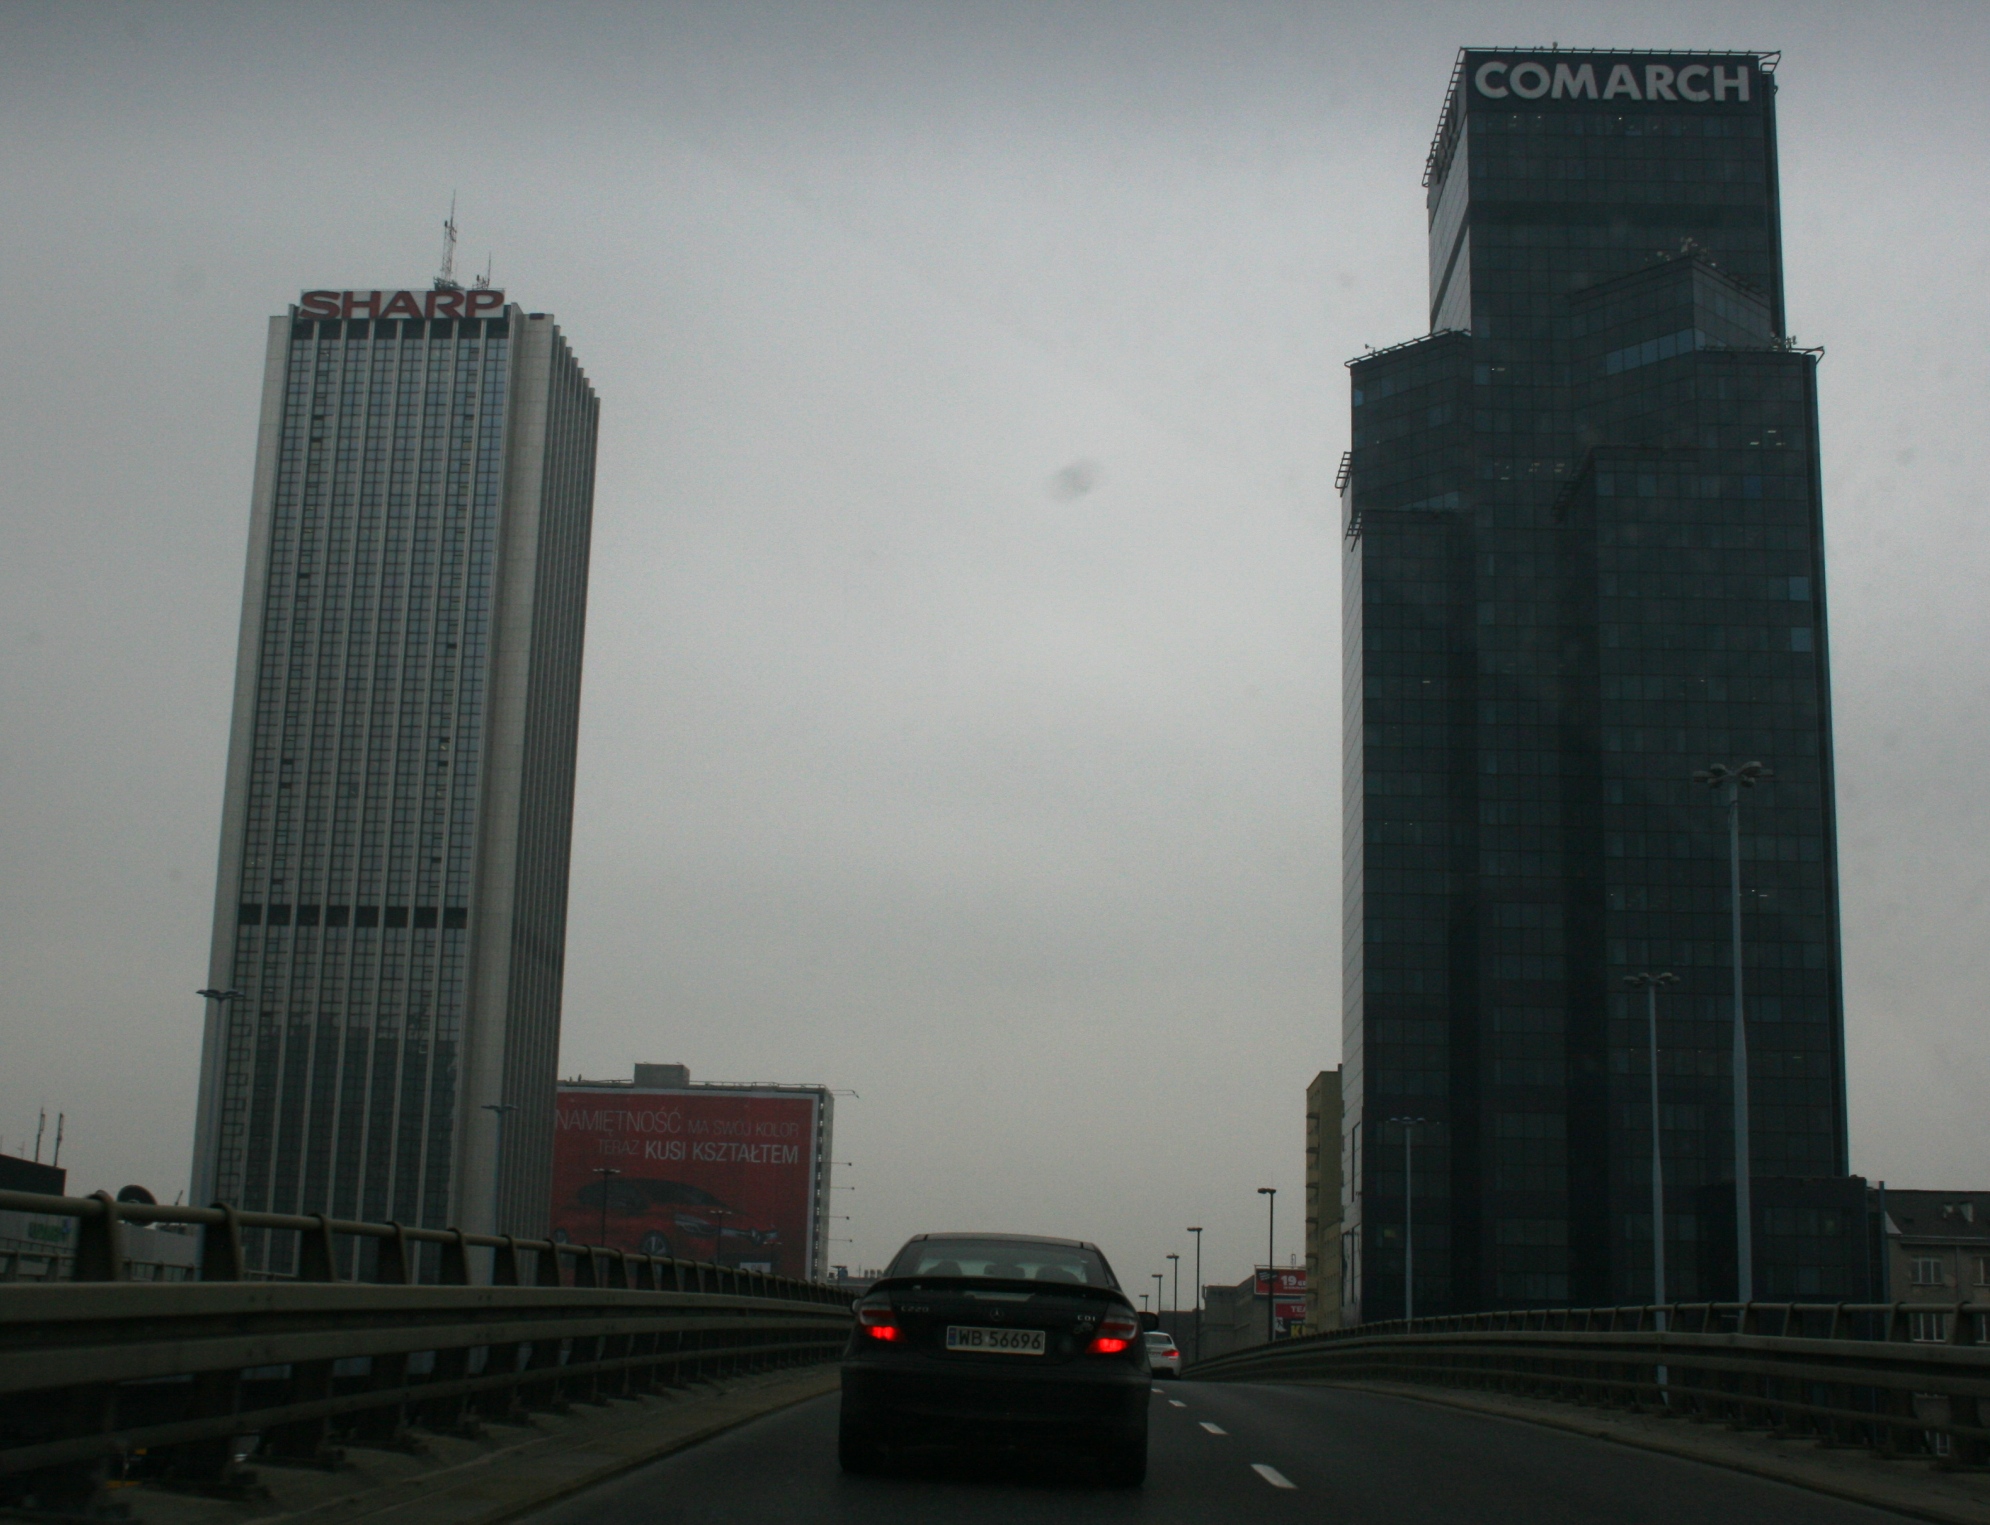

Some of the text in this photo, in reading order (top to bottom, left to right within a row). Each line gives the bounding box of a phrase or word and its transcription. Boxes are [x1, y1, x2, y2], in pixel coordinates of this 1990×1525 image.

[1475, 61, 1750, 103] COMARCH
[299, 290, 505, 320] SHARP
[556, 1106, 799, 1139] NAMIĘTNOŚĆ MA SWÓJ KOLOR
[598, 1138, 799, 1165] TERAZ KUSI KSZTAŁTEM
[959, 1329, 1041, 1349] WB 56696
